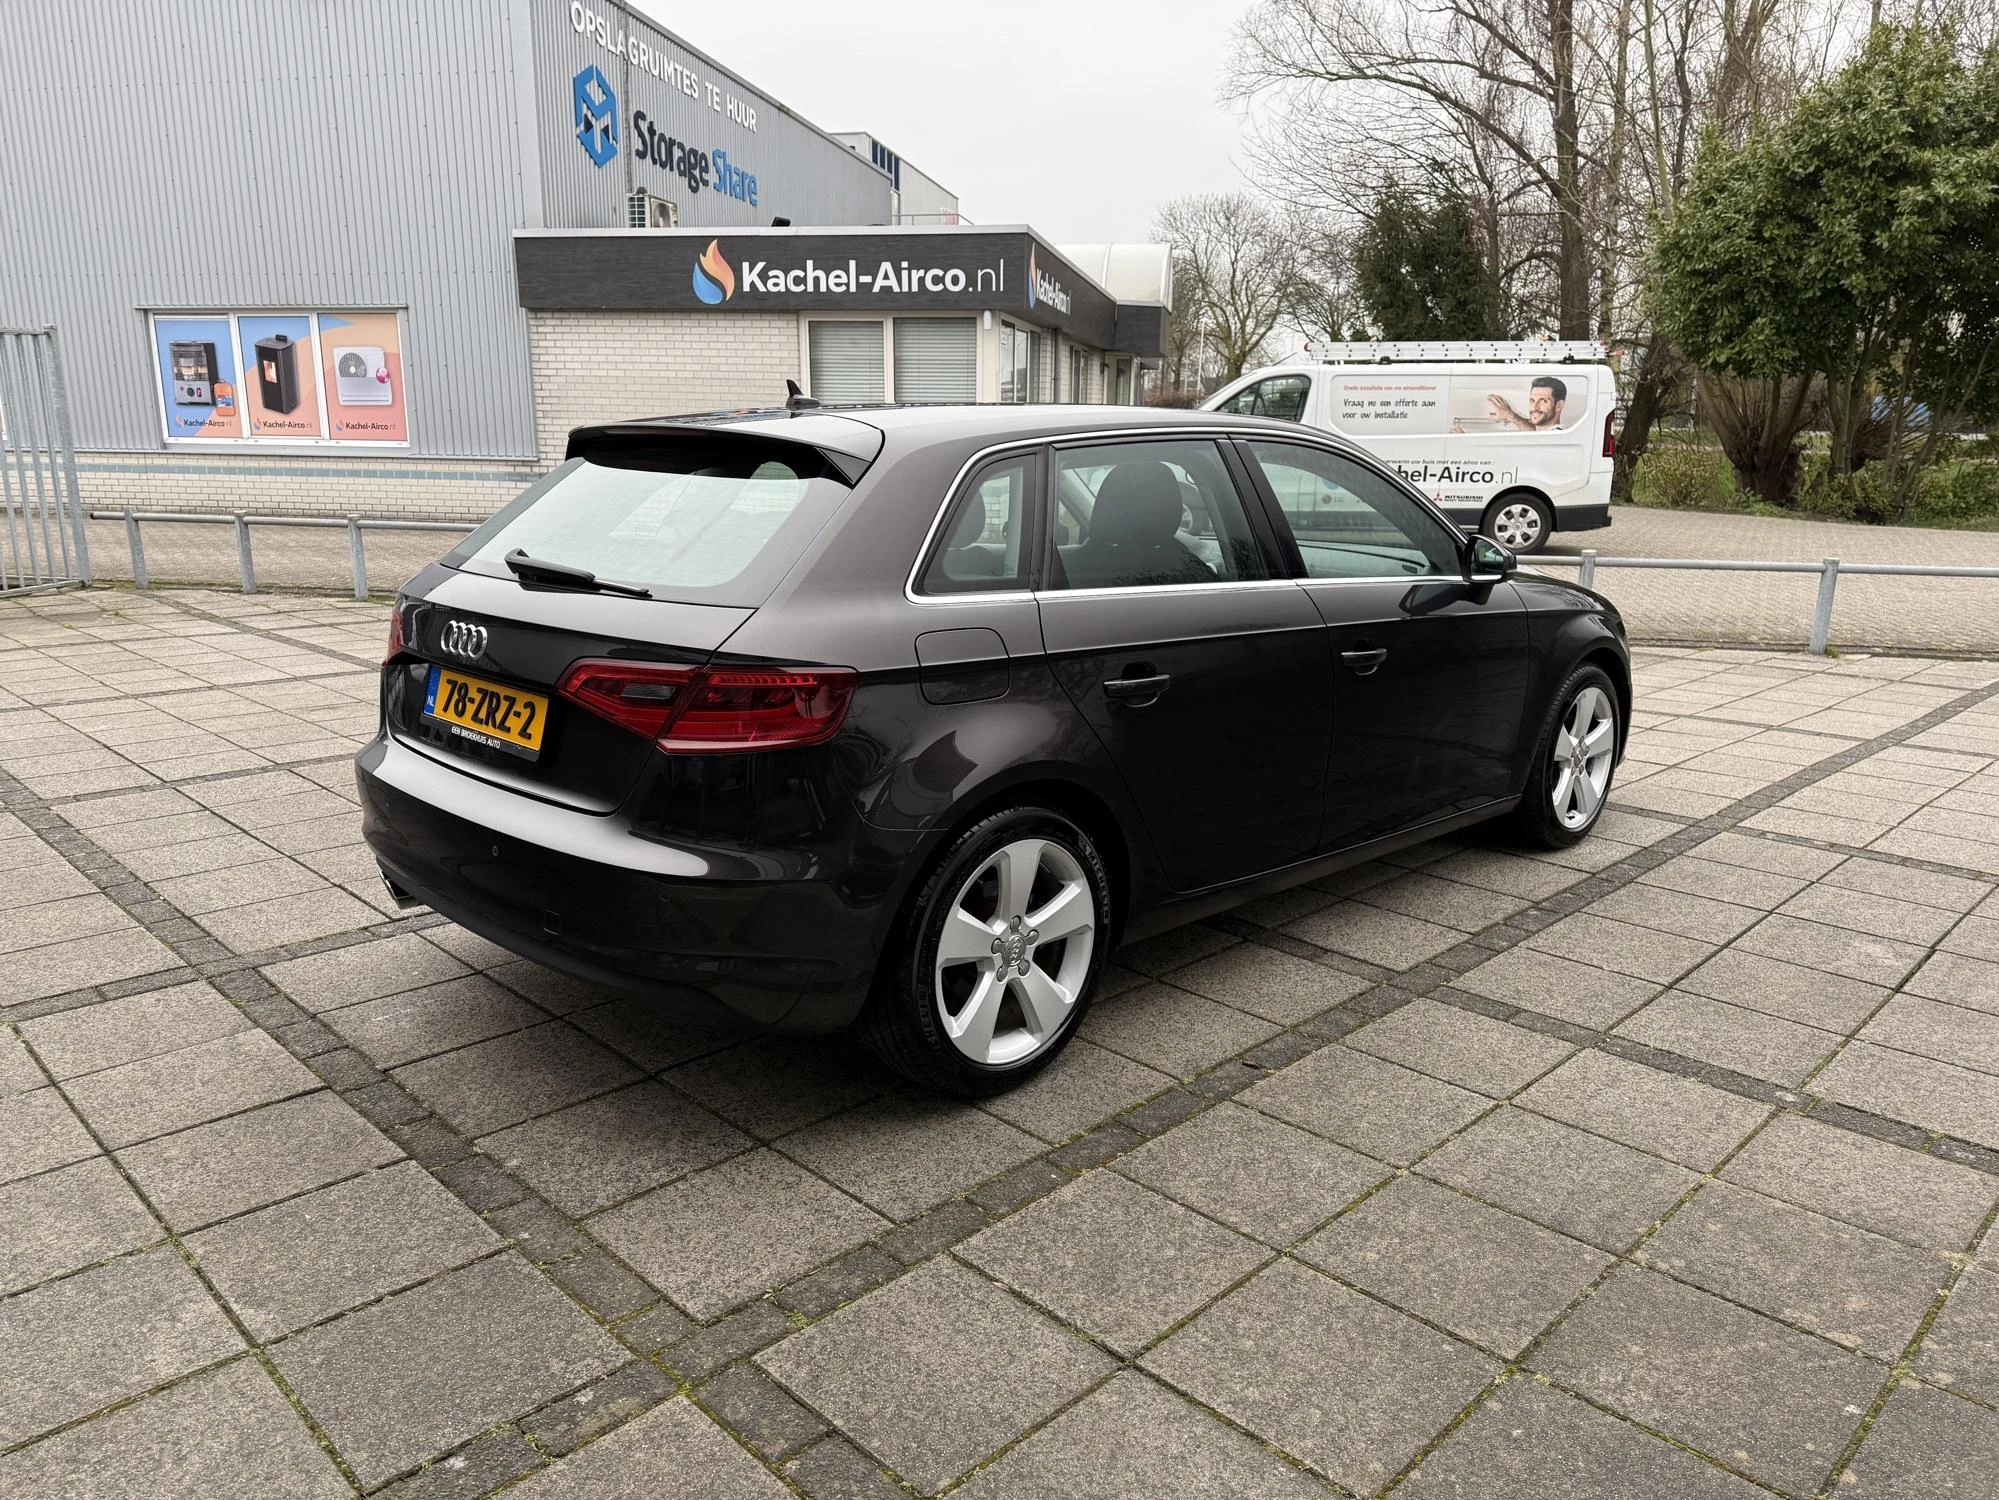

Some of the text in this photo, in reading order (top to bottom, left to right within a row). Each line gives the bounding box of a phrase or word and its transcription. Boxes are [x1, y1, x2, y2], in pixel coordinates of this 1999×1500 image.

[571, 1, 757, 132] OPSLAGRUIMTES TE HUUR
[634, 110, 757, 207] Storage Share
[742, 258, 1004, 293] Kachel-Airco.nl
[1343, 399, 1364, 408] Vraag
[1395, 398, 1418, 407] offerte
[1374, 410, 1408, 419] installatie
[1398, 465, 1518, 484] hel-Airco.nl
[427, 695, 435, 707] NL
[442, 678, 536, 740] 78-ZRZ-2
[452, 726, 460, 735] EEN
[487, 738, 500, 749] AUTO
[1087, 849, 1110, 920] MICHELIN
